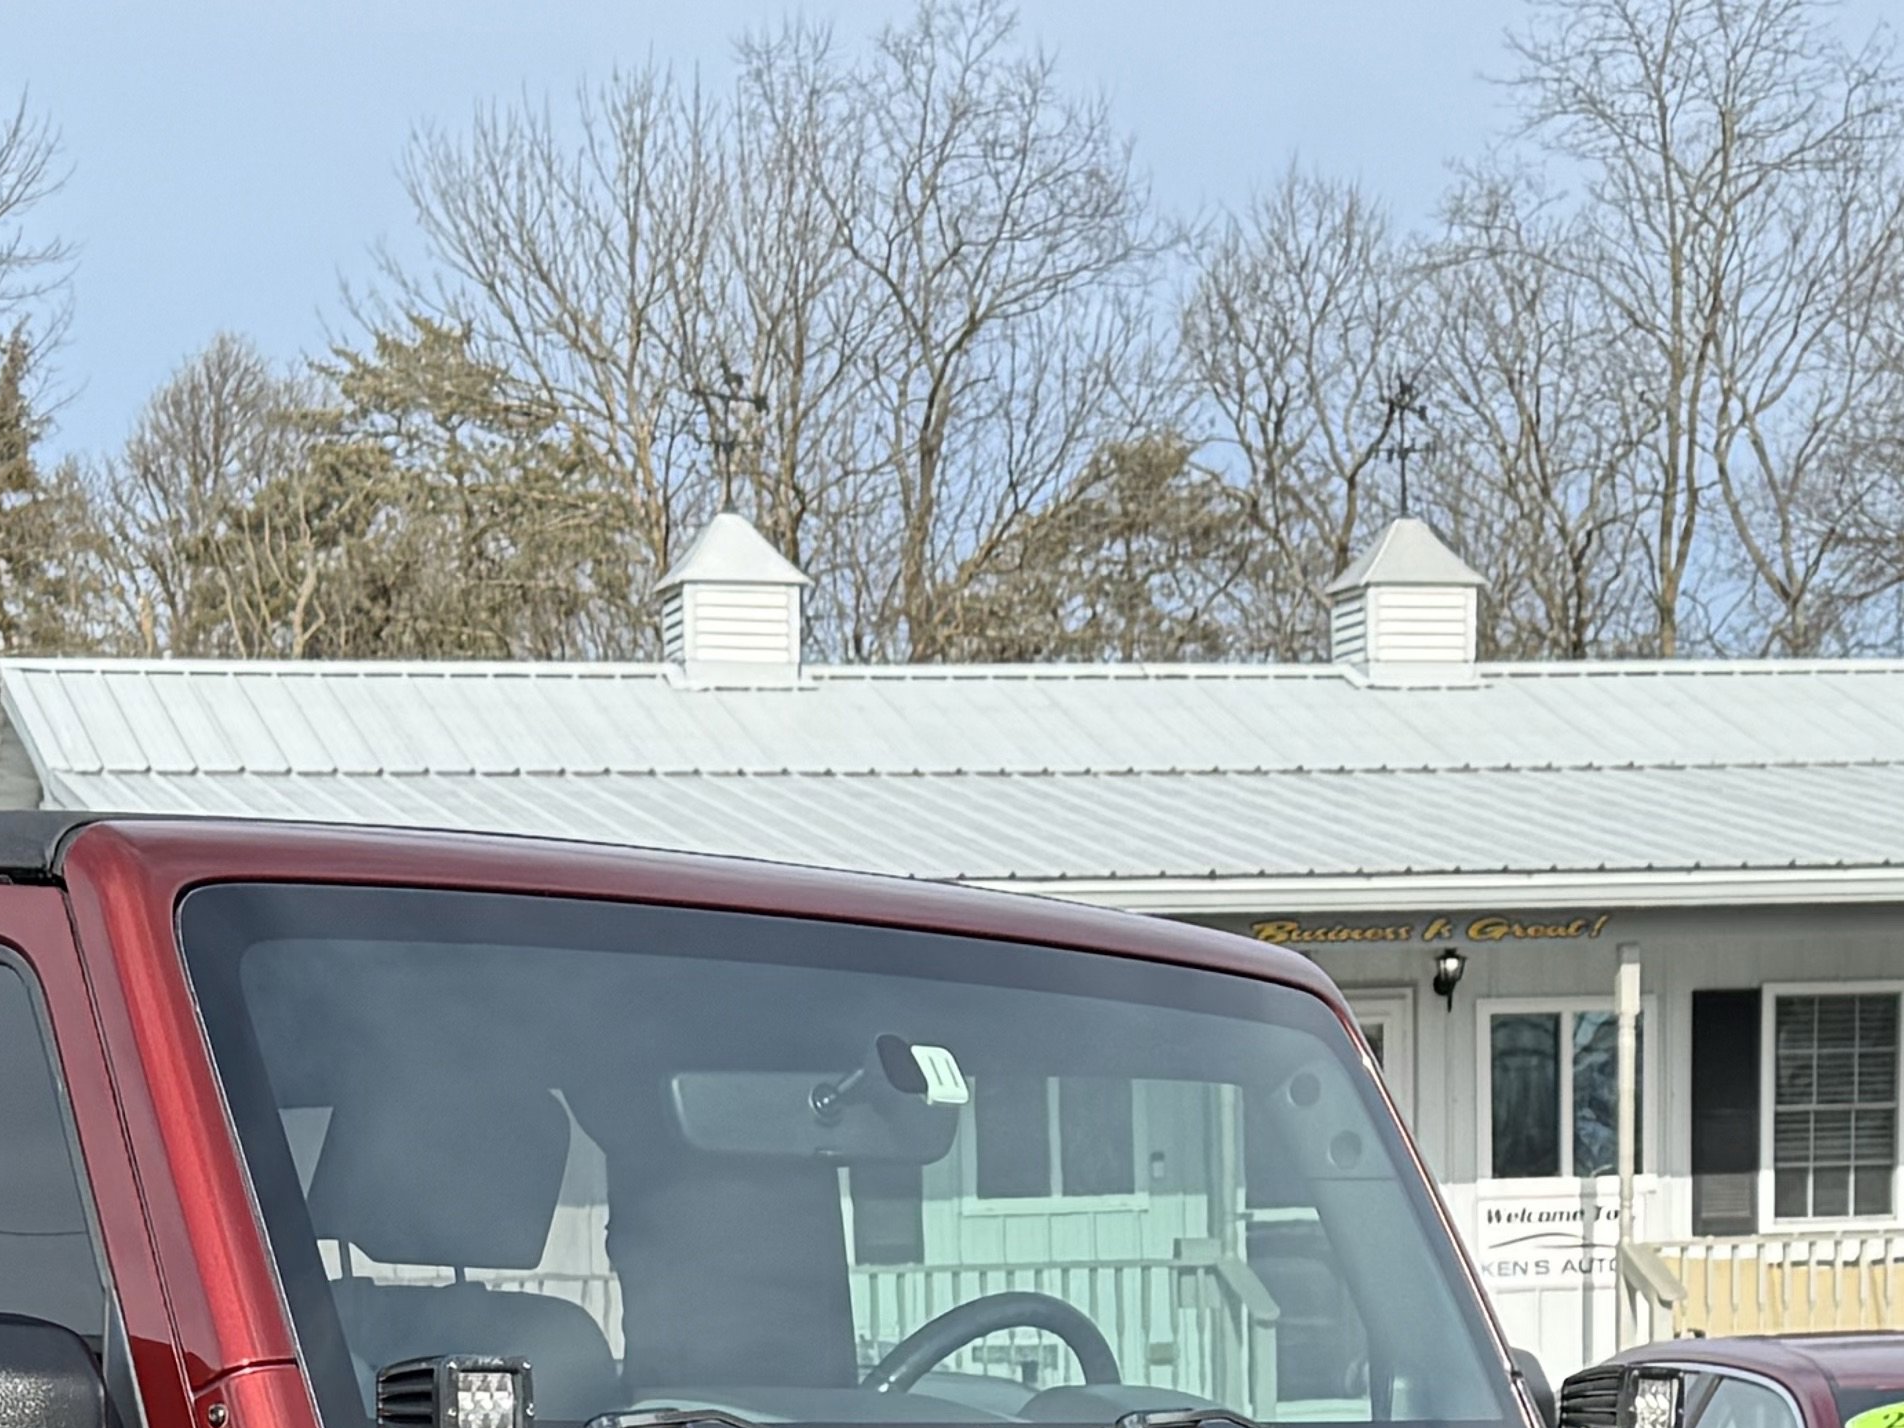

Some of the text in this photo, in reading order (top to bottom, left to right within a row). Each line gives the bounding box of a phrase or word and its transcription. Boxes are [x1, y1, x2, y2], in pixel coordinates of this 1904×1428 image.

[1250, 917, 1412, 943] Business
[1468, 913, 1612, 941] Great!
[1487, 1208, 1585, 1224] Welcome
